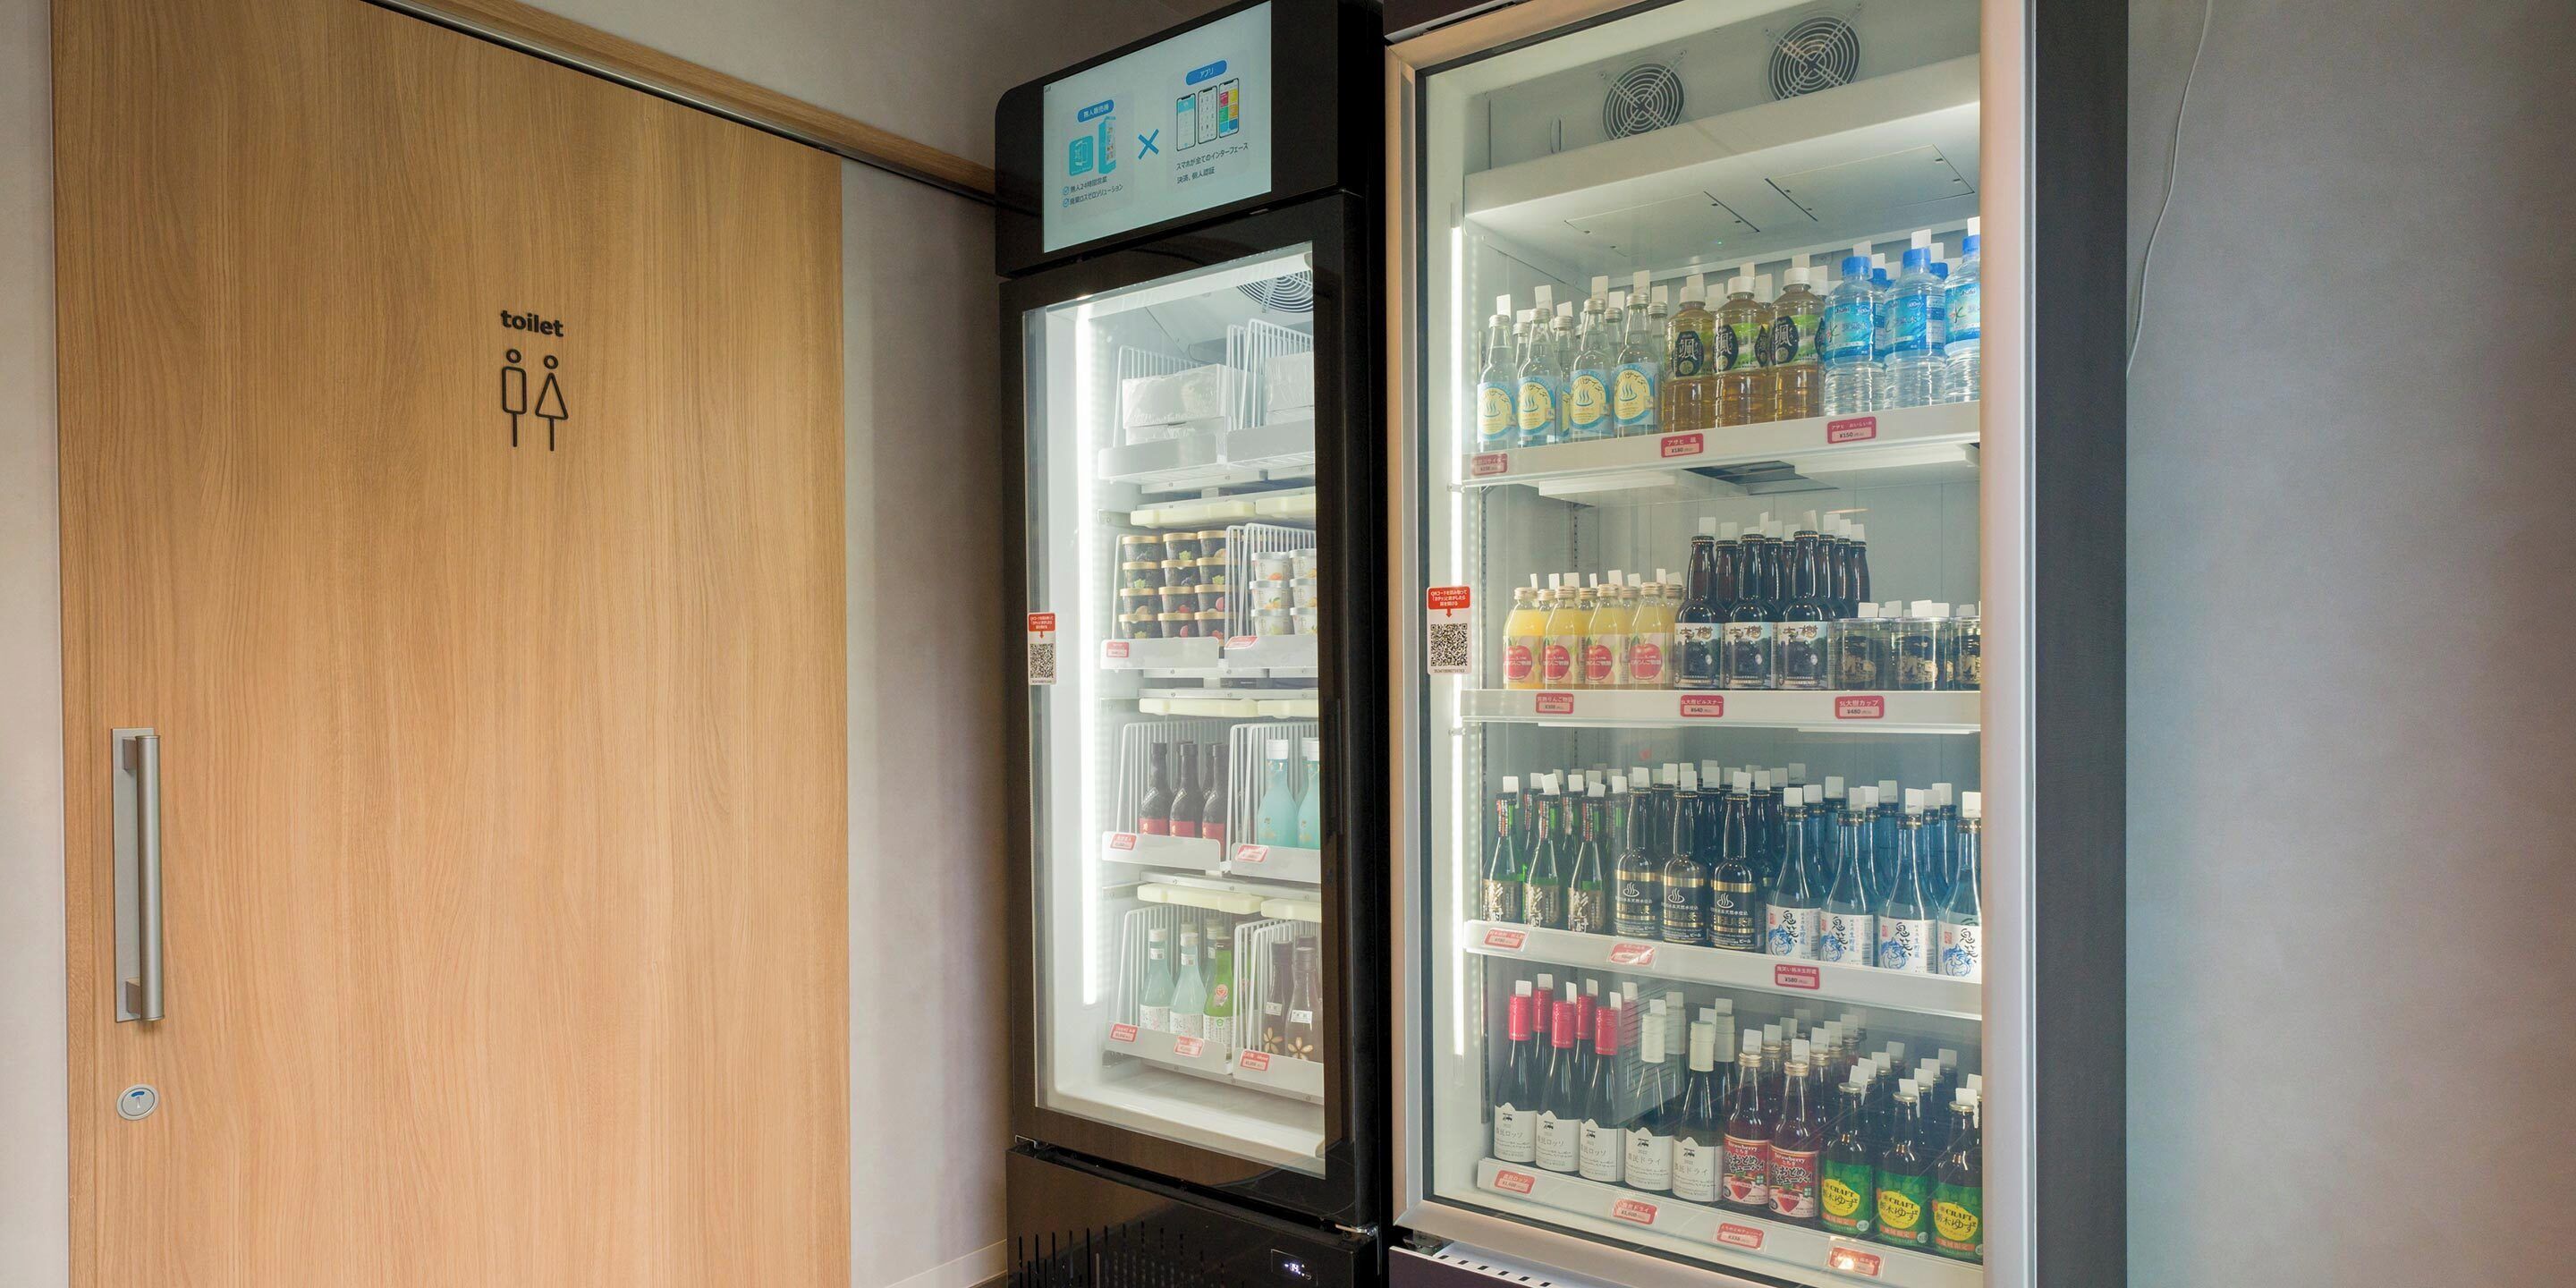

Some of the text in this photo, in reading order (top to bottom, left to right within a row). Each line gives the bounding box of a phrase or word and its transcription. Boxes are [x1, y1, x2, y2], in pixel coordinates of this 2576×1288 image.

[500, 309, 564, 337] toilet
[1830, 1184, 1855, 1197] CRAFT
[1888, 1197, 1916, 1209] CRAFT
[1945, 1208, 1973, 1221] CRAFT
